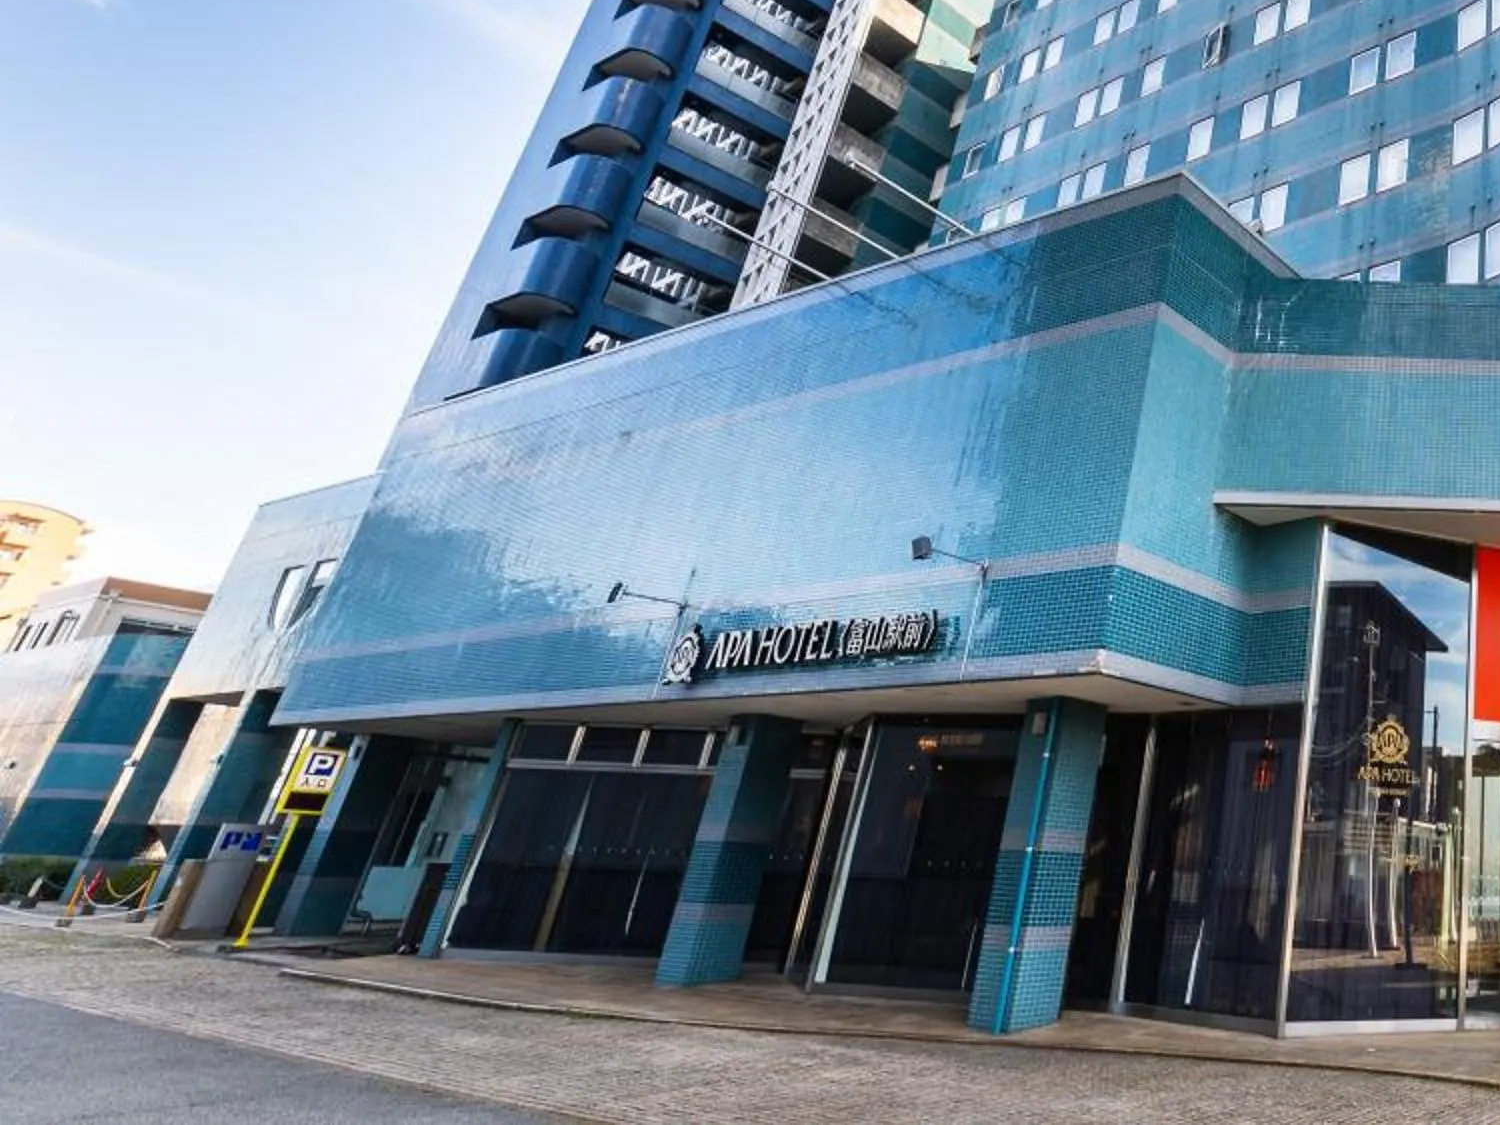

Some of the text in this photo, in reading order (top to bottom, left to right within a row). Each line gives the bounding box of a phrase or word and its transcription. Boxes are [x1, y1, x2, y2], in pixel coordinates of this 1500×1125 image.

[705, 631, 753, 670] APA
[754, 618, 834, 666] HOTEL
[308, 755, 335, 774] P
[1381, 768, 1420, 785] HOTEL
